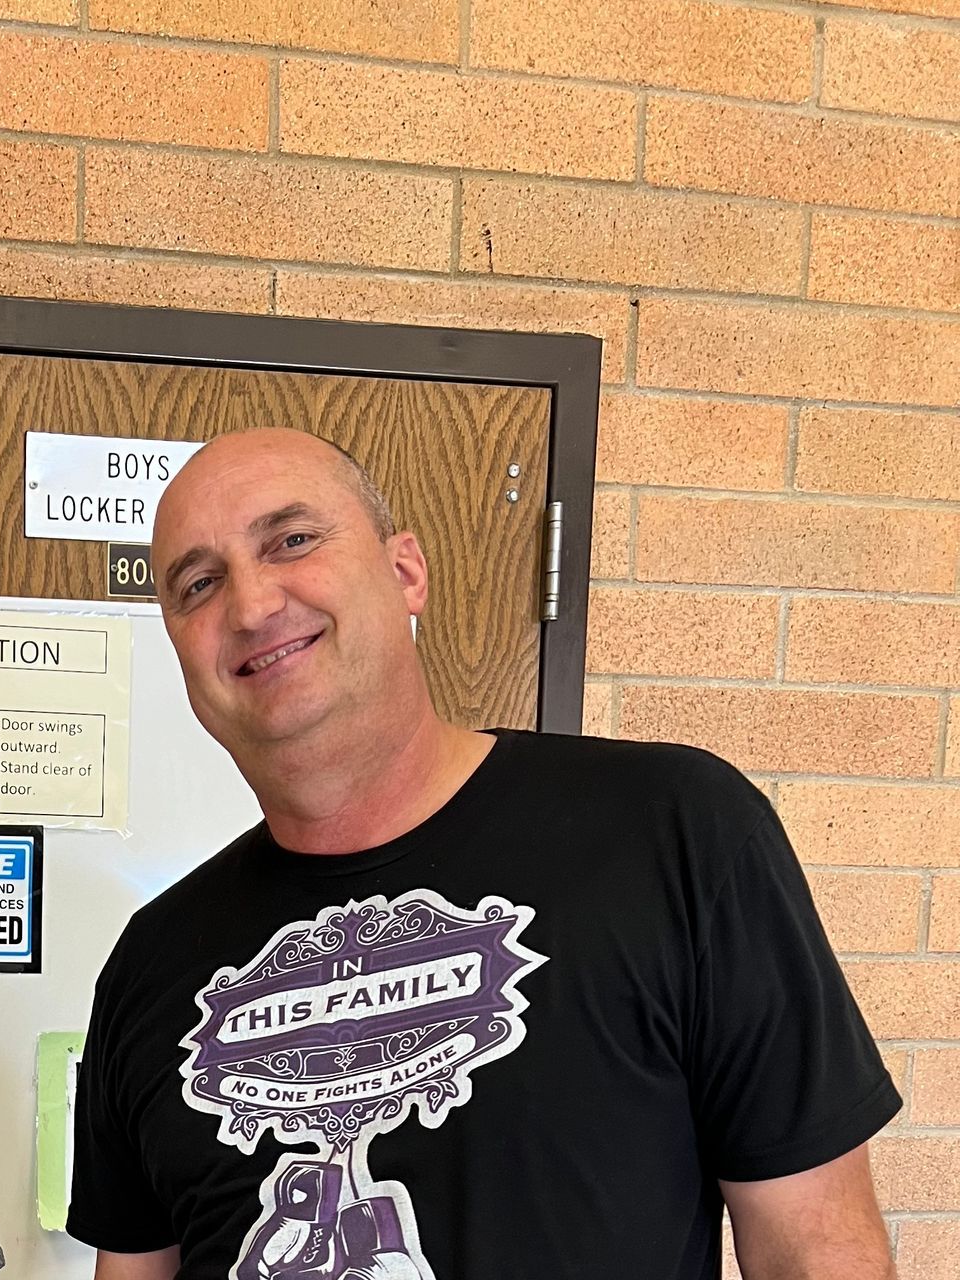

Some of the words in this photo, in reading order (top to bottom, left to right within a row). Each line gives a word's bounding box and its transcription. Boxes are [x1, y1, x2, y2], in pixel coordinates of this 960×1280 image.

[107, 452, 170, 482] BOYS
[46, 494, 145, 525] LOCKER
[116, 557, 155, 586] 80
[0, 717, 34, 732] Door
[37, 720, 83, 736] swings
[0, 740, 62, 755] outward.
[0, 761, 39, 775] Stand
[41, 762, 75, 777] clear
[77, 763, 93, 778] of
[0, 781, 36, 796] door.
[332, 956, 363, 980] IN
[227, 1000, 313, 1034] THIS
[325, 963, 476, 1014] FAMILY
[265, 1086, 308, 1103] ONE
[314, 1078, 383, 1101] FIGHTS
[390, 1045, 456, 1087] ALONE
